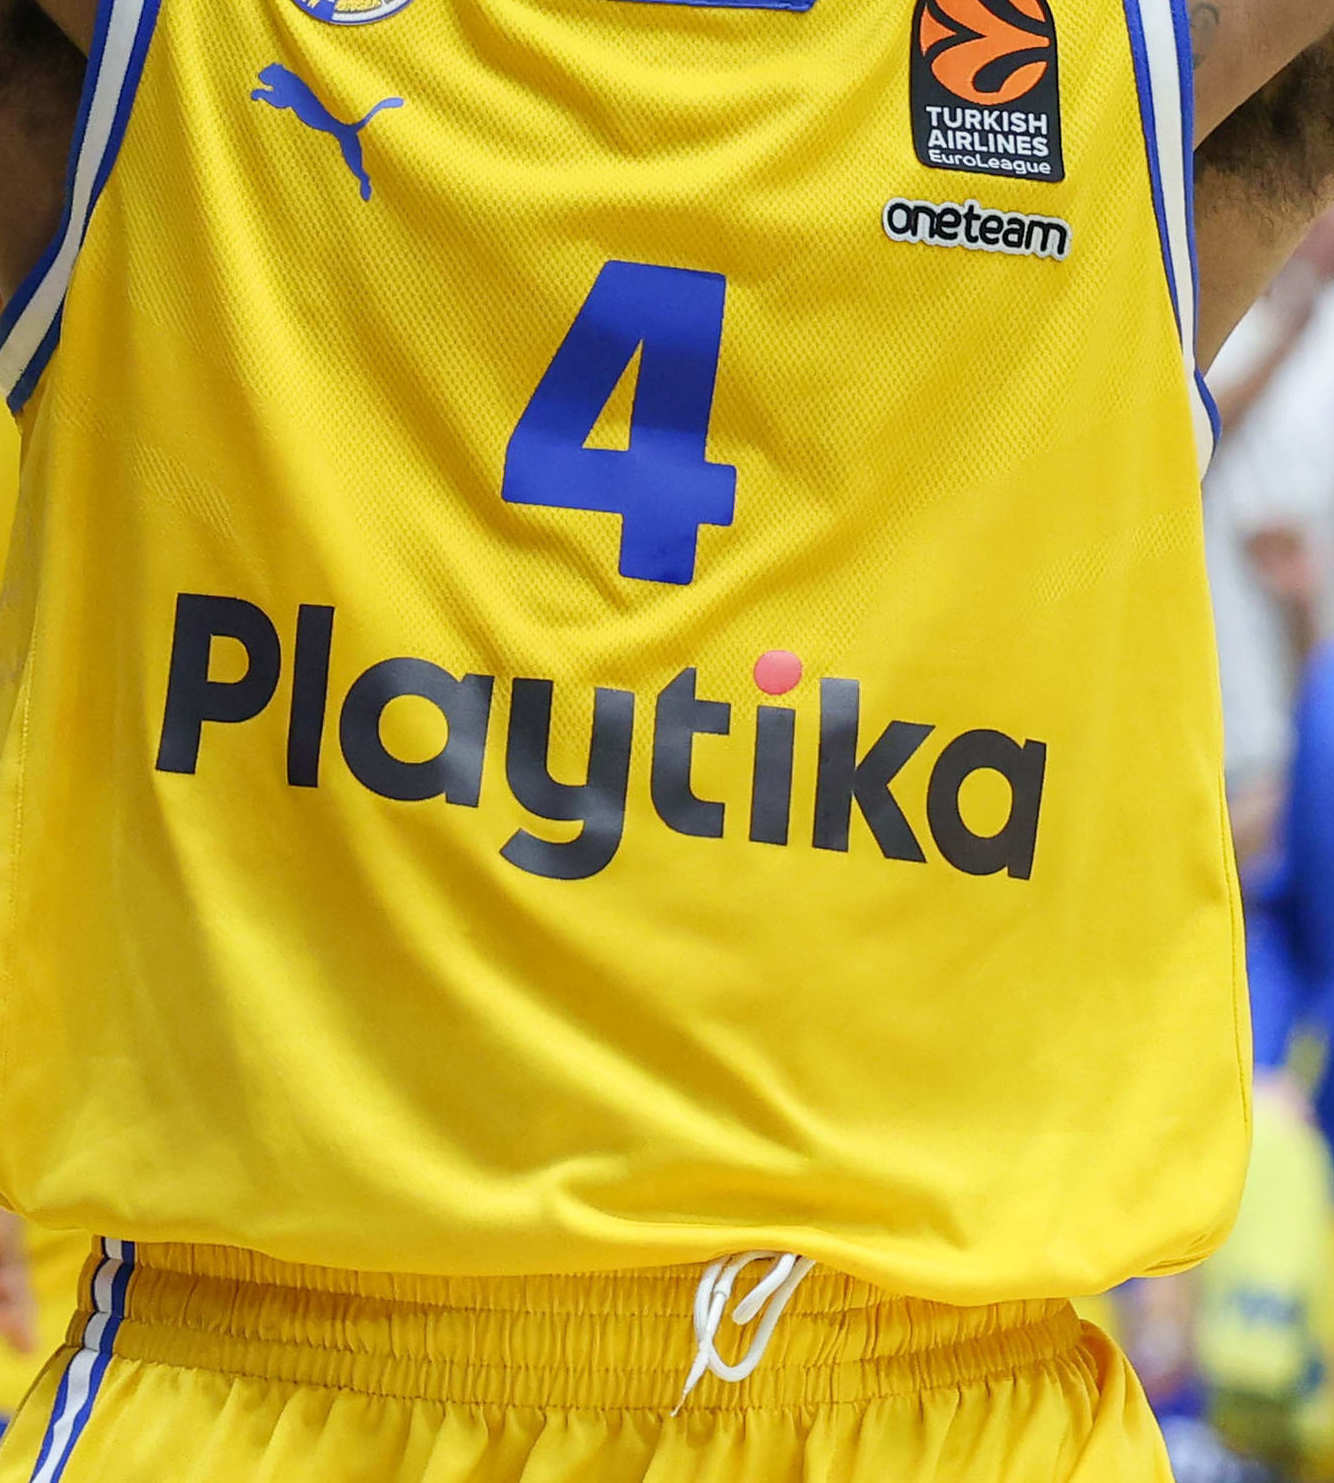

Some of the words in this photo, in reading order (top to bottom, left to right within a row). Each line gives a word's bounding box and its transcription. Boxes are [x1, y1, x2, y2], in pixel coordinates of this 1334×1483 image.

[925, 105, 1049, 135] TURKISH
[927, 128, 1049, 158] AIRLINES
[928, 149, 1052, 175] EuroLeague
[886, 202, 1068, 255] oneteam
[501, 259, 737, 587] 4
[154, 591, 1048, 882] Playtika
